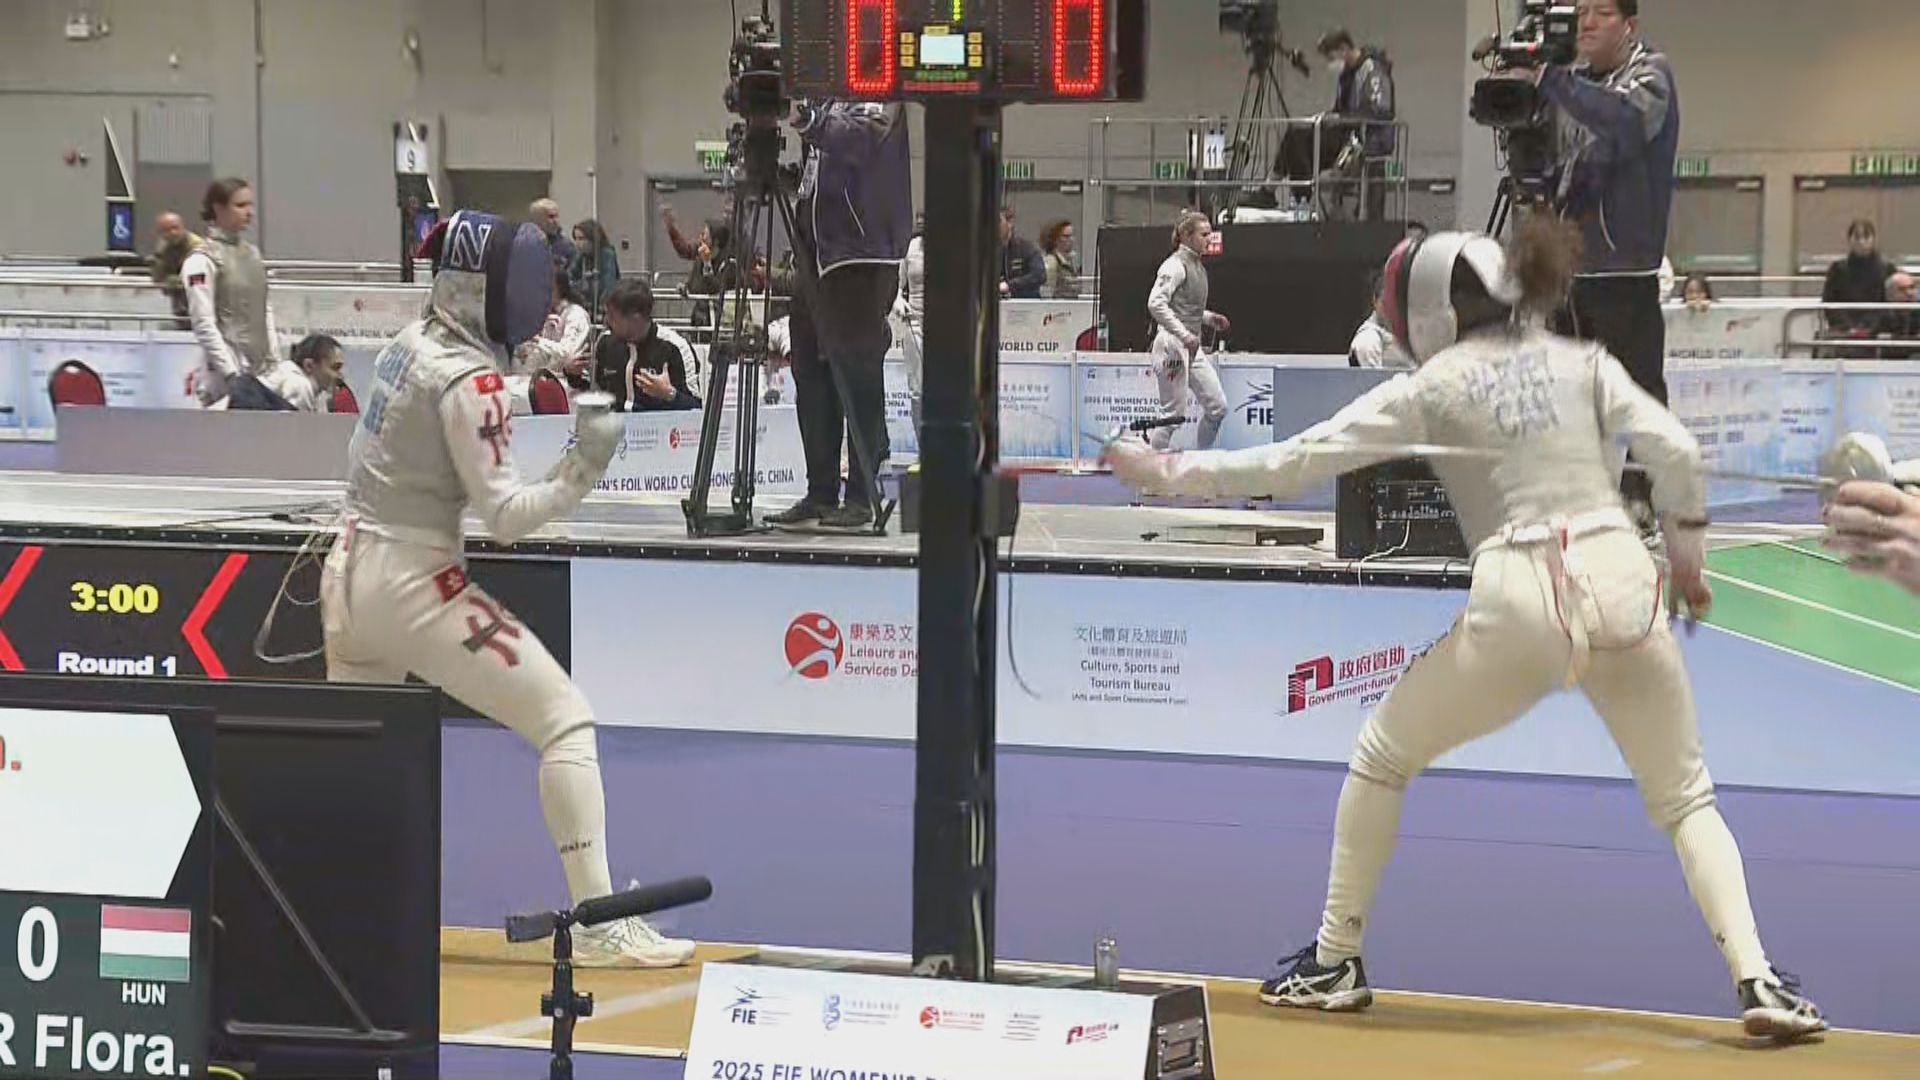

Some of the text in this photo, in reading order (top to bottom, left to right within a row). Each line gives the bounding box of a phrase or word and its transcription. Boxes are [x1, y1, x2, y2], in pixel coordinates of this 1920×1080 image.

[1206, 145, 1218, 165] 11
[1037, 341, 1060, 351] CUP
[1247, 408, 1273, 425] FIE
[621, 477, 642, 491] FOIL
[644, 475, 678, 491] WORLD
[768, 468, 794, 483] CHINA
[70, 582, 159, 613] 3:00
[849, 644, 895, 660] Leisure
[58, 652, 176, 677] Round 1
[844, 662, 898, 677] Services
[1080, 659, 1181, 676] Culture, Sports and
[1338, 644, 1406, 681] 政府資助
[1090, 676, 1171, 692] Tourism Bureau
[17, 906, 59, 981] 0
[121, 982, 166, 1006] HUN
[731, 1008, 758, 1025] FIE
[35, 1014, 190, 1077] Flora.
[712, 1060, 764, 1080] 2025
